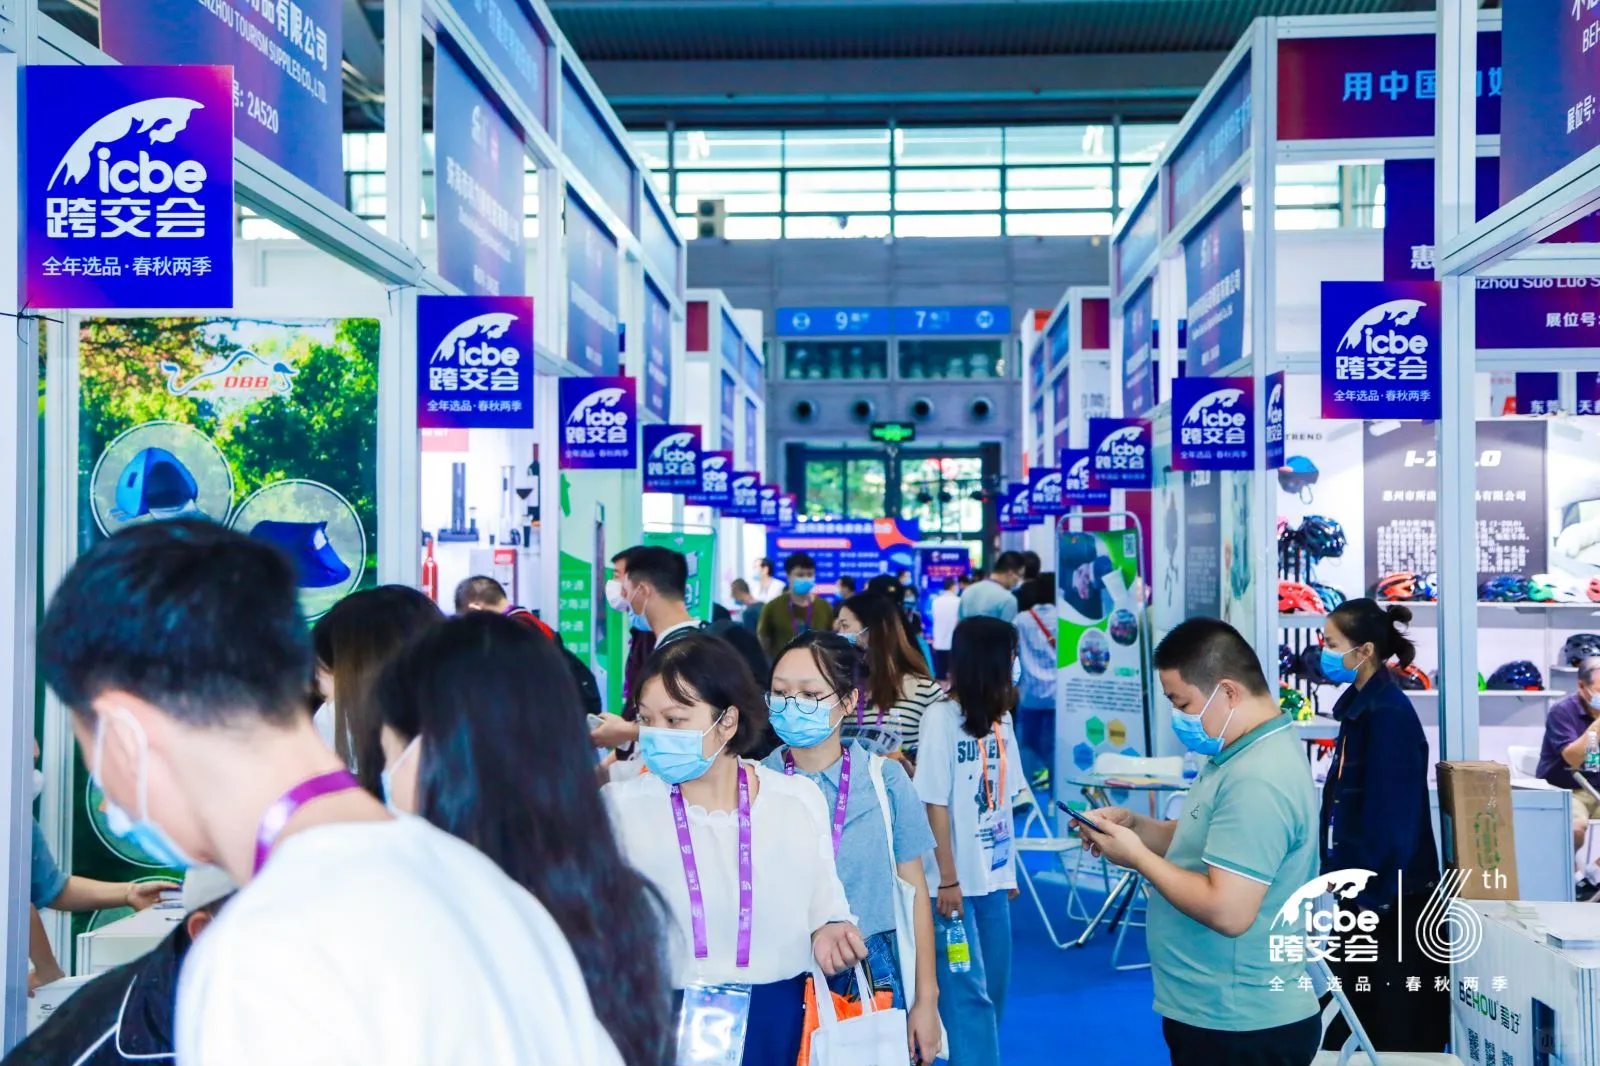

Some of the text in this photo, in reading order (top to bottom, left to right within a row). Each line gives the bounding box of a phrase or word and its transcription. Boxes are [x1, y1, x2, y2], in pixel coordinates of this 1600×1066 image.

[246, 0, 327, 71] 品有限公司
[247, 91, 279, 134] 2A520
[97, 147, 207, 193] icbe
[46, 197, 206, 238] 跨交会
[42, 256, 212, 276] 全年选品·春秋两季
[1475, 277, 1519, 290] izhou
[1522, 277, 1554, 289] Suo
[1557, 277, 1587, 288] Luo
[1365, 327, 1428, 355] icbe
[458, 340, 520, 367] icbe
[429, 367, 519, 391] 跨交会
[1335, 356, 1428, 381] 跨交会
[224, 375, 270, 389] DBB
[585, 407, 628, 426] icbe
[1201, 407, 1246, 427] icbe
[565, 426, 628, 443] 跨交会
[1181, 427, 1245, 444] 跨交会
[1111, 441, 1145, 456] icbe
